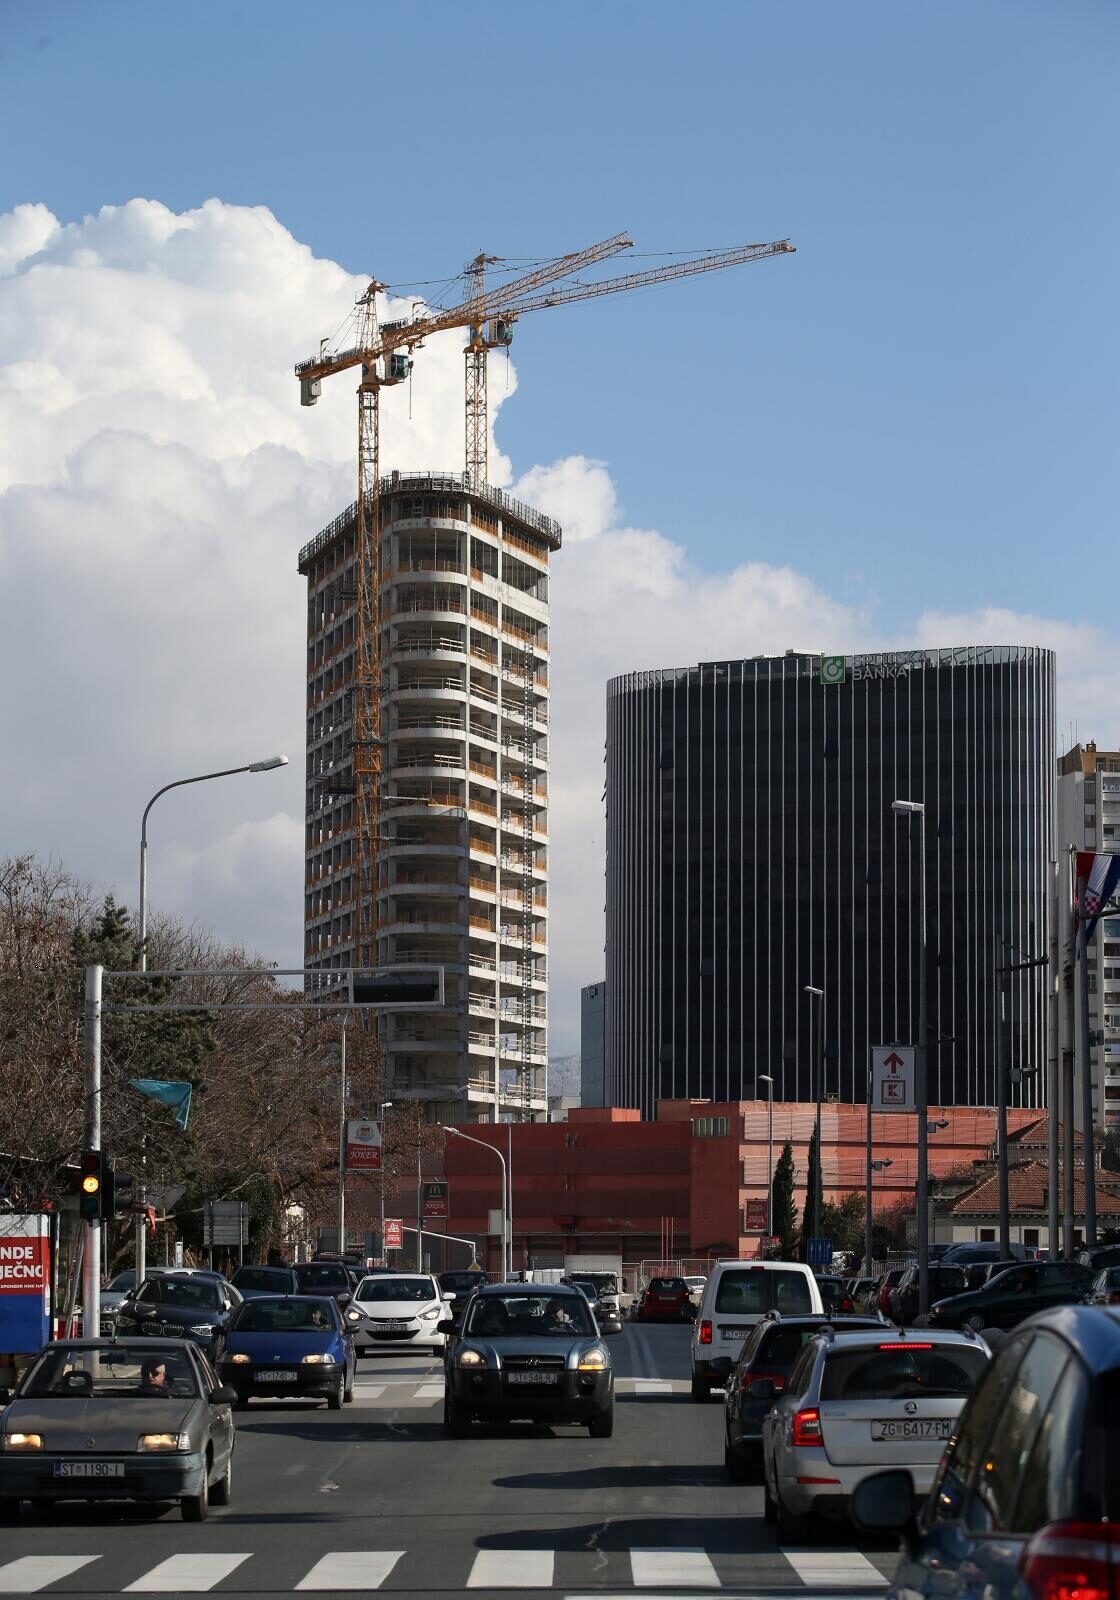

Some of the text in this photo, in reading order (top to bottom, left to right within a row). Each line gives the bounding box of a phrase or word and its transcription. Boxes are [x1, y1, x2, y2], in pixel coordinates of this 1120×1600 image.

[853, 667, 908, 681] BANKA
[350, 1151, 379, 1160] JOKER
[0, 1246, 34, 1260] NDE
[512, 1373, 522, 1382] ST
[881, 1423, 896, 1436] ZG
[62, 1463, 75, 1475] ST
